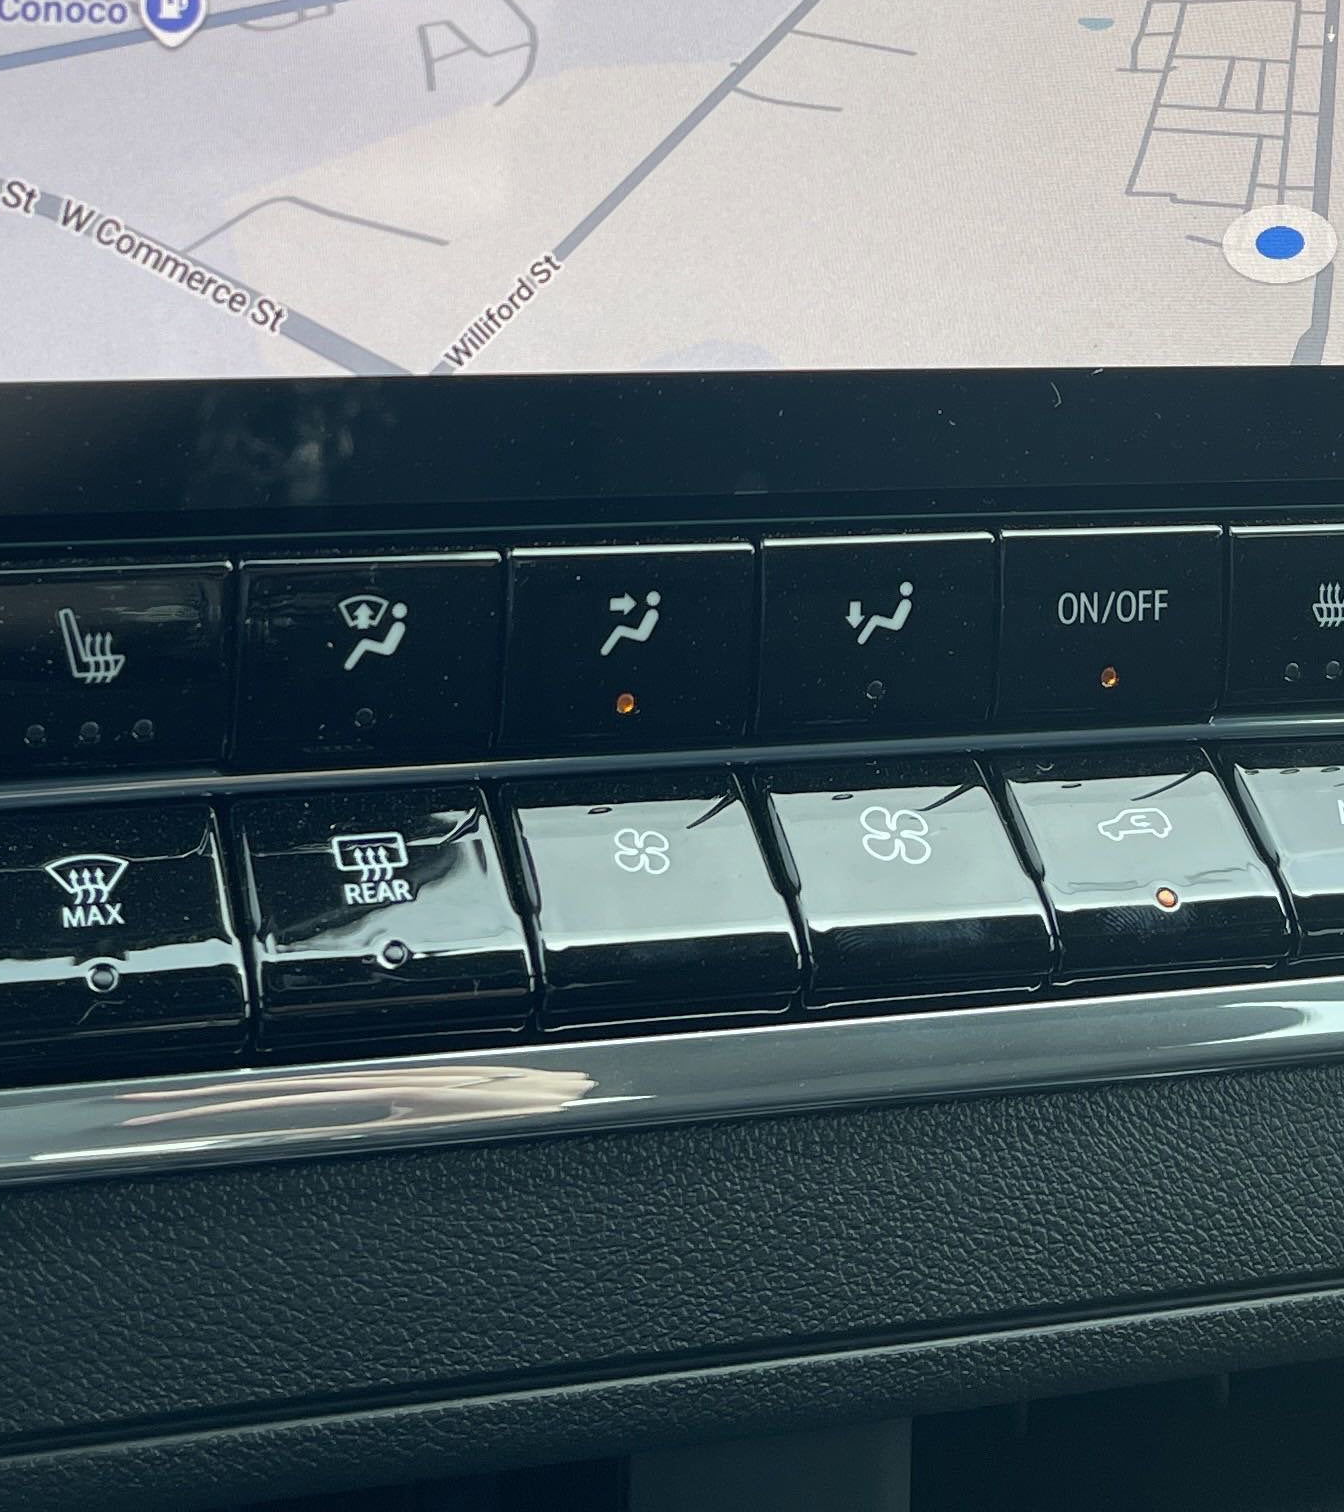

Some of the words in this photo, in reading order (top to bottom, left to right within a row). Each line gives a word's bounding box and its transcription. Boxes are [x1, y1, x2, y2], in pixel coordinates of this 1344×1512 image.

[0, 179, 39, 216] St
[58, 197, 95, 235] W
[93, 219, 249, 315] Commerce
[251, 299, 288, 335] St
[444, 277, 535, 372] Williford
[524, 252, 563, 291] St
[1057, 588, 1170, 627] ON/OFF
[343, 878, 413, 905] REAR
[61, 902, 126, 929] MAX
